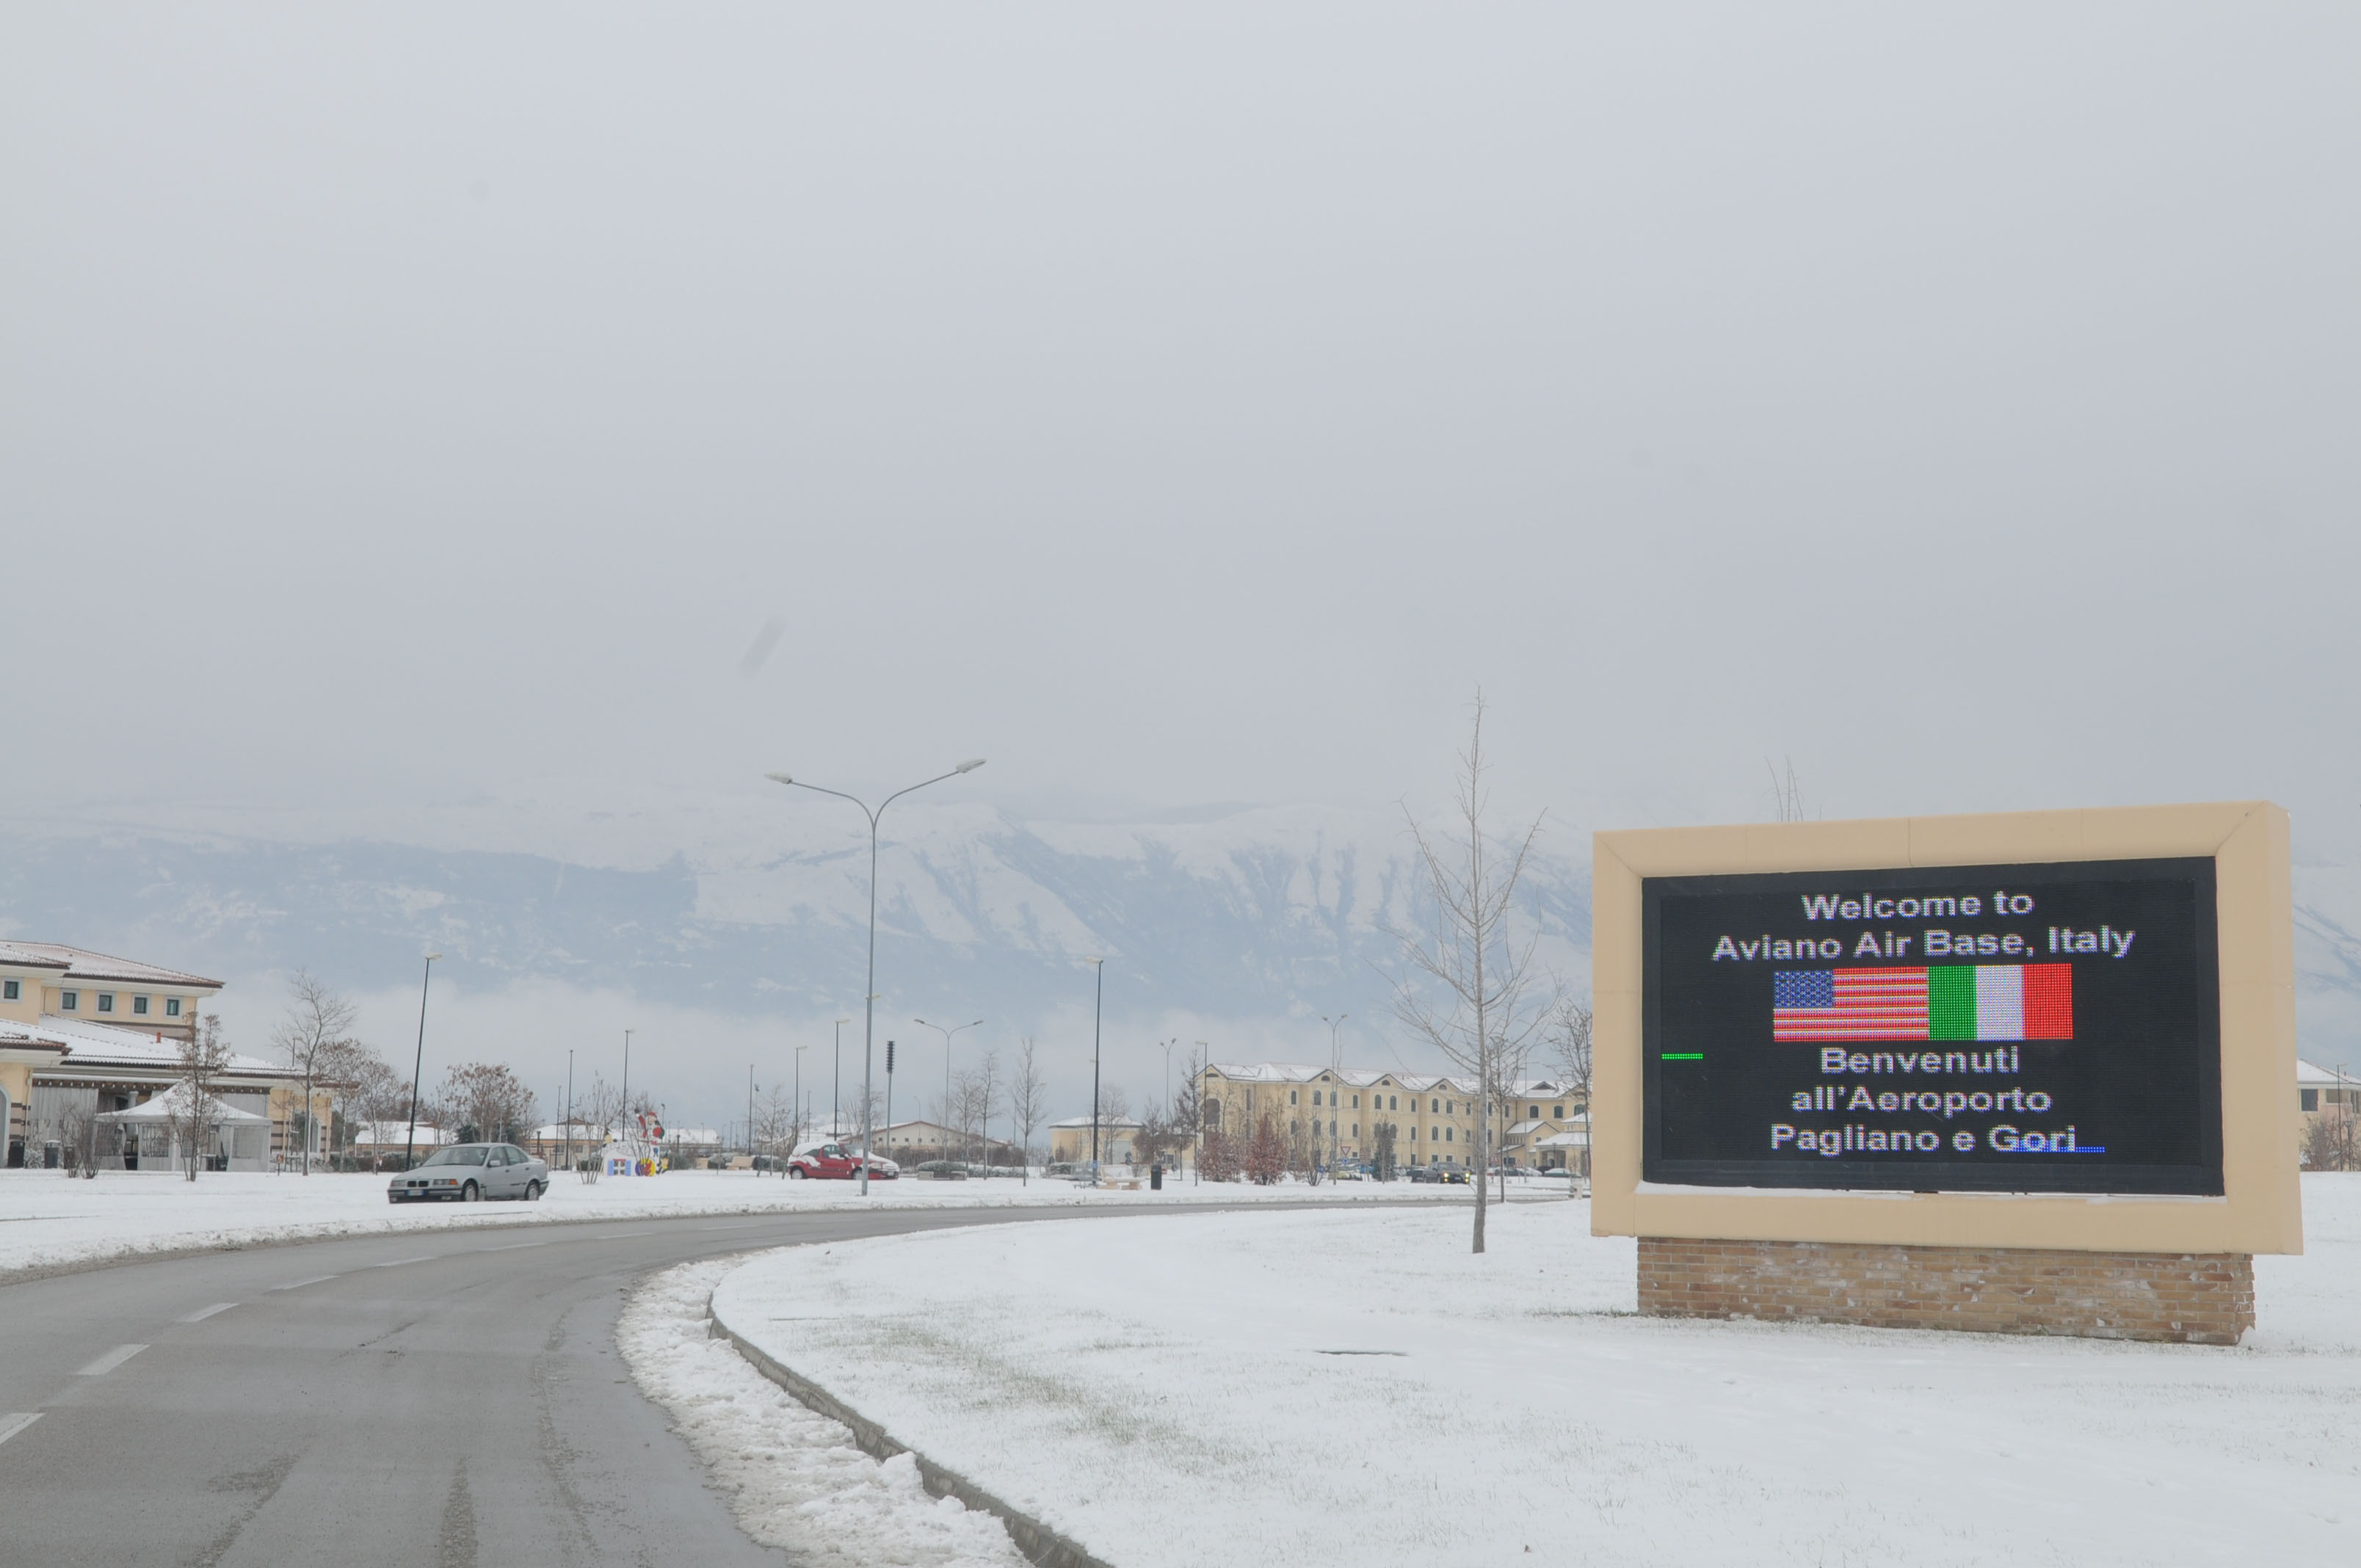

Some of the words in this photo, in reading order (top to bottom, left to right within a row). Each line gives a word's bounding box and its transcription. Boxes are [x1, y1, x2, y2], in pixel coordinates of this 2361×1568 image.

[1802, 893, 1980, 920] Welcome
[1994, 890, 2034, 915] to
[1712, 934, 1843, 960] Aviano
[1854, 932, 1912, 957] Air
[1923, 929, 2034, 957] Base,
[2048, 926, 2136, 957] Italy
[1820, 1046, 2019, 1072] Benvenuti
[1791, 1086, 2053, 1118] all'Aeroporto
[1770, 1125, 1940, 1156] Pagliano
[1952, 1130, 1976, 1150] e
[1988, 1125, 2076, 1152] Gori
